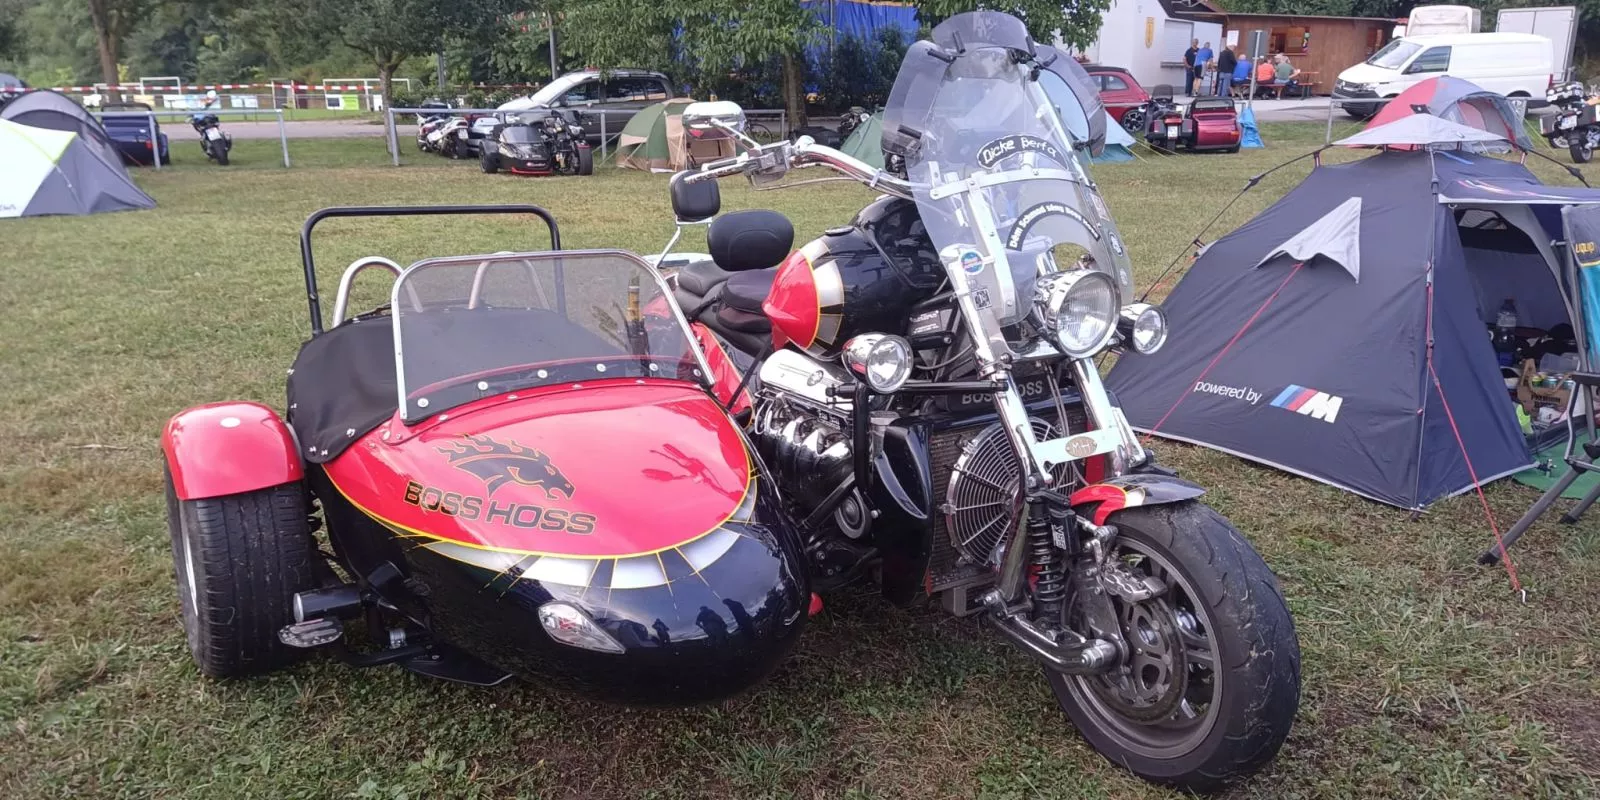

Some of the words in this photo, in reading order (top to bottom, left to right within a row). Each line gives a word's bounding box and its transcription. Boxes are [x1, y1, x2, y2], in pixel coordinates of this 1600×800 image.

[983, 139, 1016, 164] Dicke
[962, 392, 995, 405] BOS
[1018, 380, 1043, 398] OSS
[1193, 381, 1246, 399] powered
[1246, 387, 1262, 405] by
[1296, 391, 1344, 424] M
[404, 480, 483, 521] BOSS
[486, 501, 597, 535] HOSS
